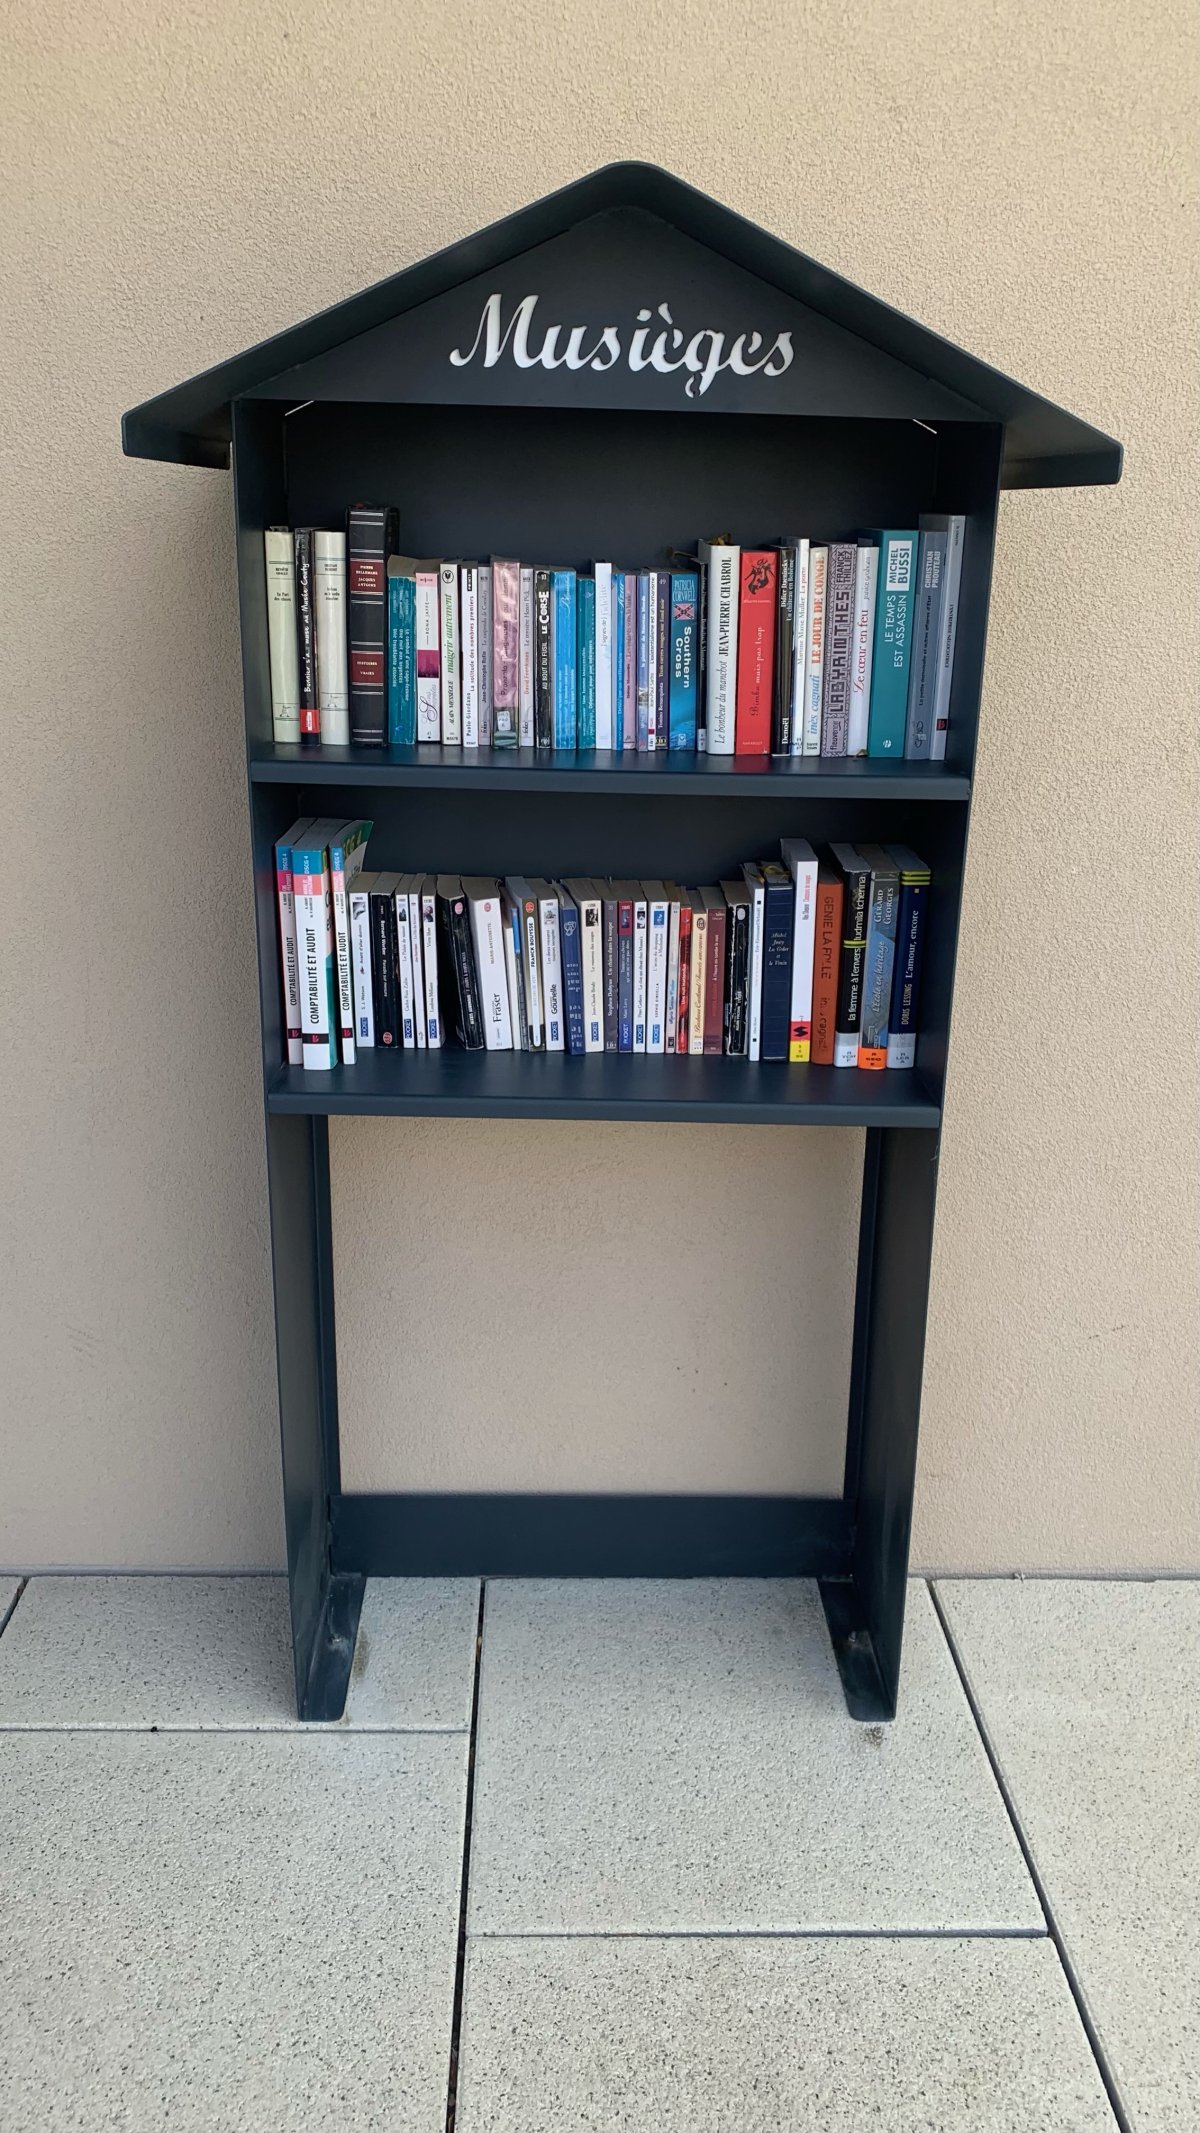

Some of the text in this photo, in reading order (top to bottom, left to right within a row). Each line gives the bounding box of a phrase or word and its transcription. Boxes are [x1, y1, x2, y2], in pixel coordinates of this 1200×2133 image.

[449, 293, 794, 399] Musièges
[836, 551, 845, 583] FRANCK
[844, 551, 852, 583] THILLIEZ
[889, 548, 899, 584] MICHEL
[898, 548, 910, 584] BUSSI
[924, 551, 934, 588] CHRISTIAN
[932, 551, 941, 588] PROUTEAU
[444, 594, 453, 639] autrement
[538, 591, 550, 624] CORSE
[814, 598, 823, 613] DE
[858, 609, 869, 628] feu
[884, 595, 896, 642] LE TEMPS
[755, 627, 765, 644] trop
[812, 617, 822, 648] JOUR
[859, 630, 868, 643] en
[894, 595, 907, 667] EST ASSASSIN
[444, 640, 455, 673] maigrir
[675, 638, 683, 678] Cross
[683, 626, 692, 689] Southern
[714, 558, 732, 744] Le bonheur du manchot JEAN-PIERRE CHABROL
[756, 647, 765, 661] pas
[811, 649, 821, 664] LE
[830, 591, 850, 712] LABYRINTHES
[857, 646, 866, 674] cœur
[303, 666, 311, 693] Bonnier
[809, 674, 820, 712] cagnati
[853, 676, 865, 694] Le
[782, 718, 790, 744] Denoël
[807, 715, 818, 735] inès
[854, 876, 866, 910] tcherina
[883, 888, 894, 925] GEORGES
[822, 896, 834, 945] GENIE LA
[852, 911, 863, 941] ludmila
[306, 928, 316, 953] AUDIT
[286, 936, 298, 1006] COMPTABILITÉ ET AUDIT
[306, 955, 317, 964] ET
[338, 931, 350, 1011] COMPTABILITÉ ET AUDIT
[850, 948, 861, 977] l'envers
[901, 910, 919, 1025] DORIS LESSING L'amour, encore
[871, 941, 889, 1012] L'École en héritage
[306, 966, 320, 1024] COMPTABILITÉ
[492, 993, 502, 1023] Fraser
[550, 984, 558, 1014] Gounelle
[848, 985, 858, 1012] femme
[847, 1013, 856, 1021] la
